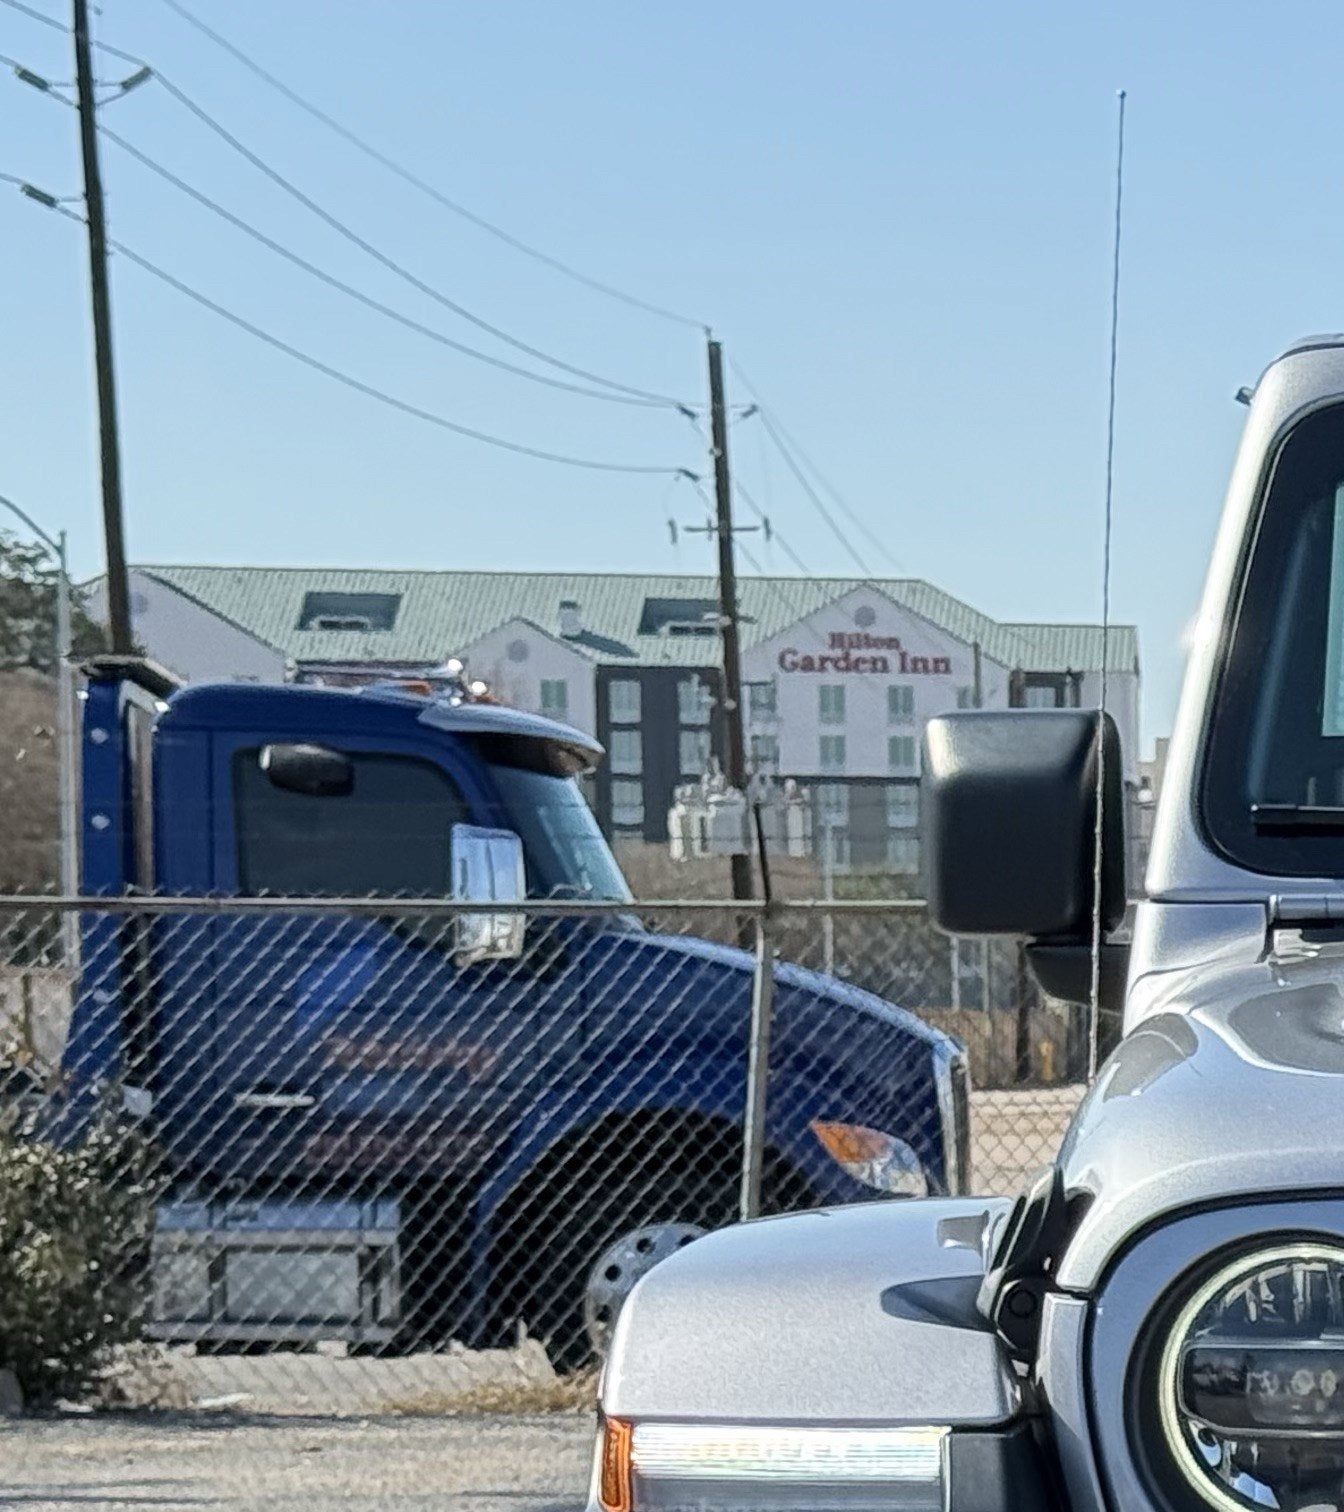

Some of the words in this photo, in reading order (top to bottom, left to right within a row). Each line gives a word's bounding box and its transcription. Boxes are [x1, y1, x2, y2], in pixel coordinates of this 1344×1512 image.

[829, 632, 901, 650] Hilton
[778, 648, 889, 674] Garden
[898, 651, 952, 675] Inn
